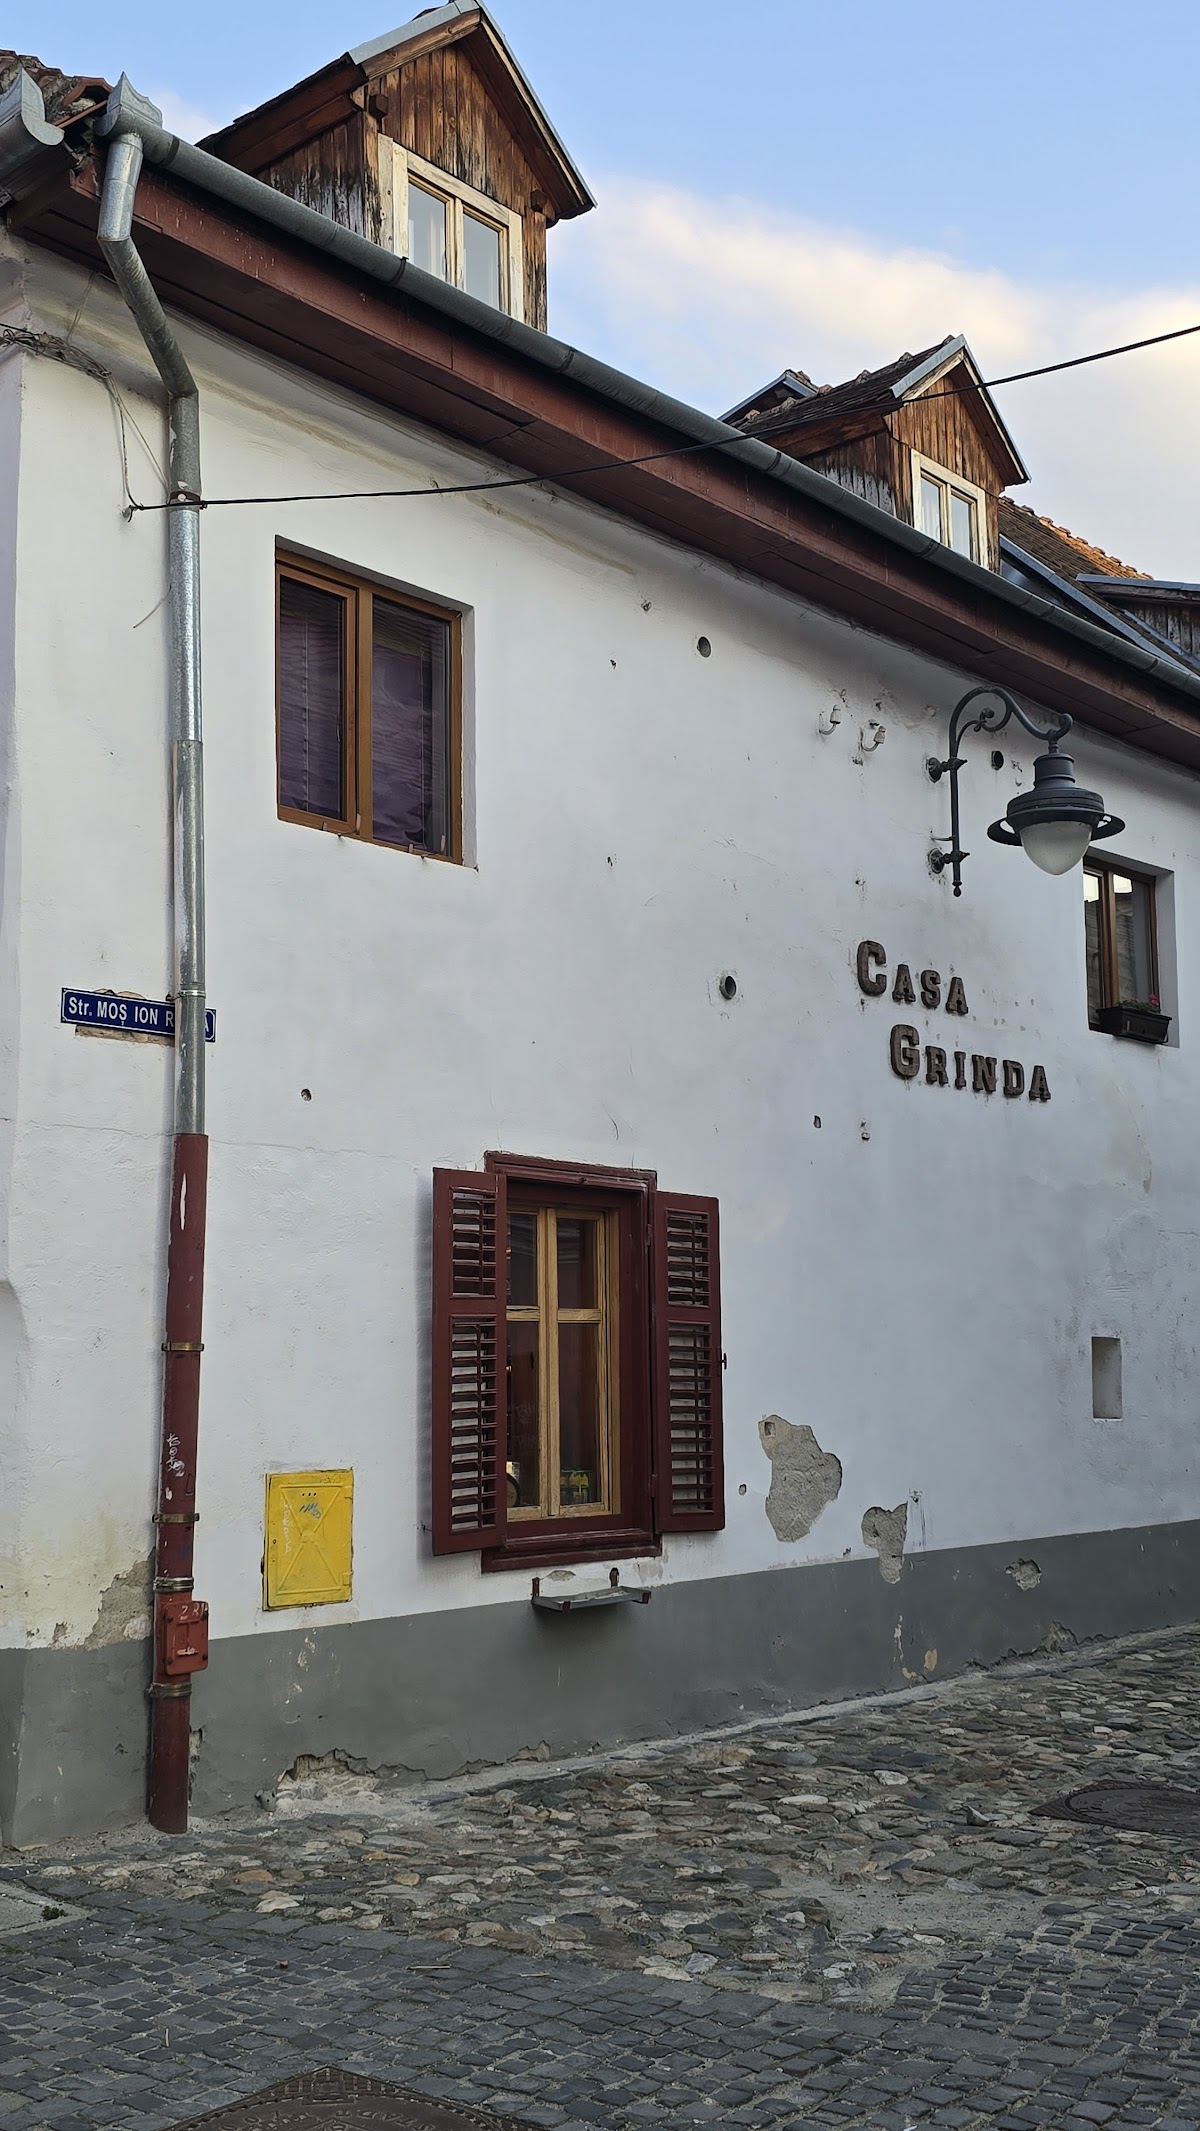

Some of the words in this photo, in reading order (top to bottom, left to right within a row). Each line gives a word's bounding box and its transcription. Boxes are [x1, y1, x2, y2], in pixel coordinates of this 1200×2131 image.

[68, 996, 92, 1016] Str.
[134, 1006, 158, 1025] ION
[857, 940, 969, 1015] CASA
[890, 1023, 1051, 1102] GRINDA
